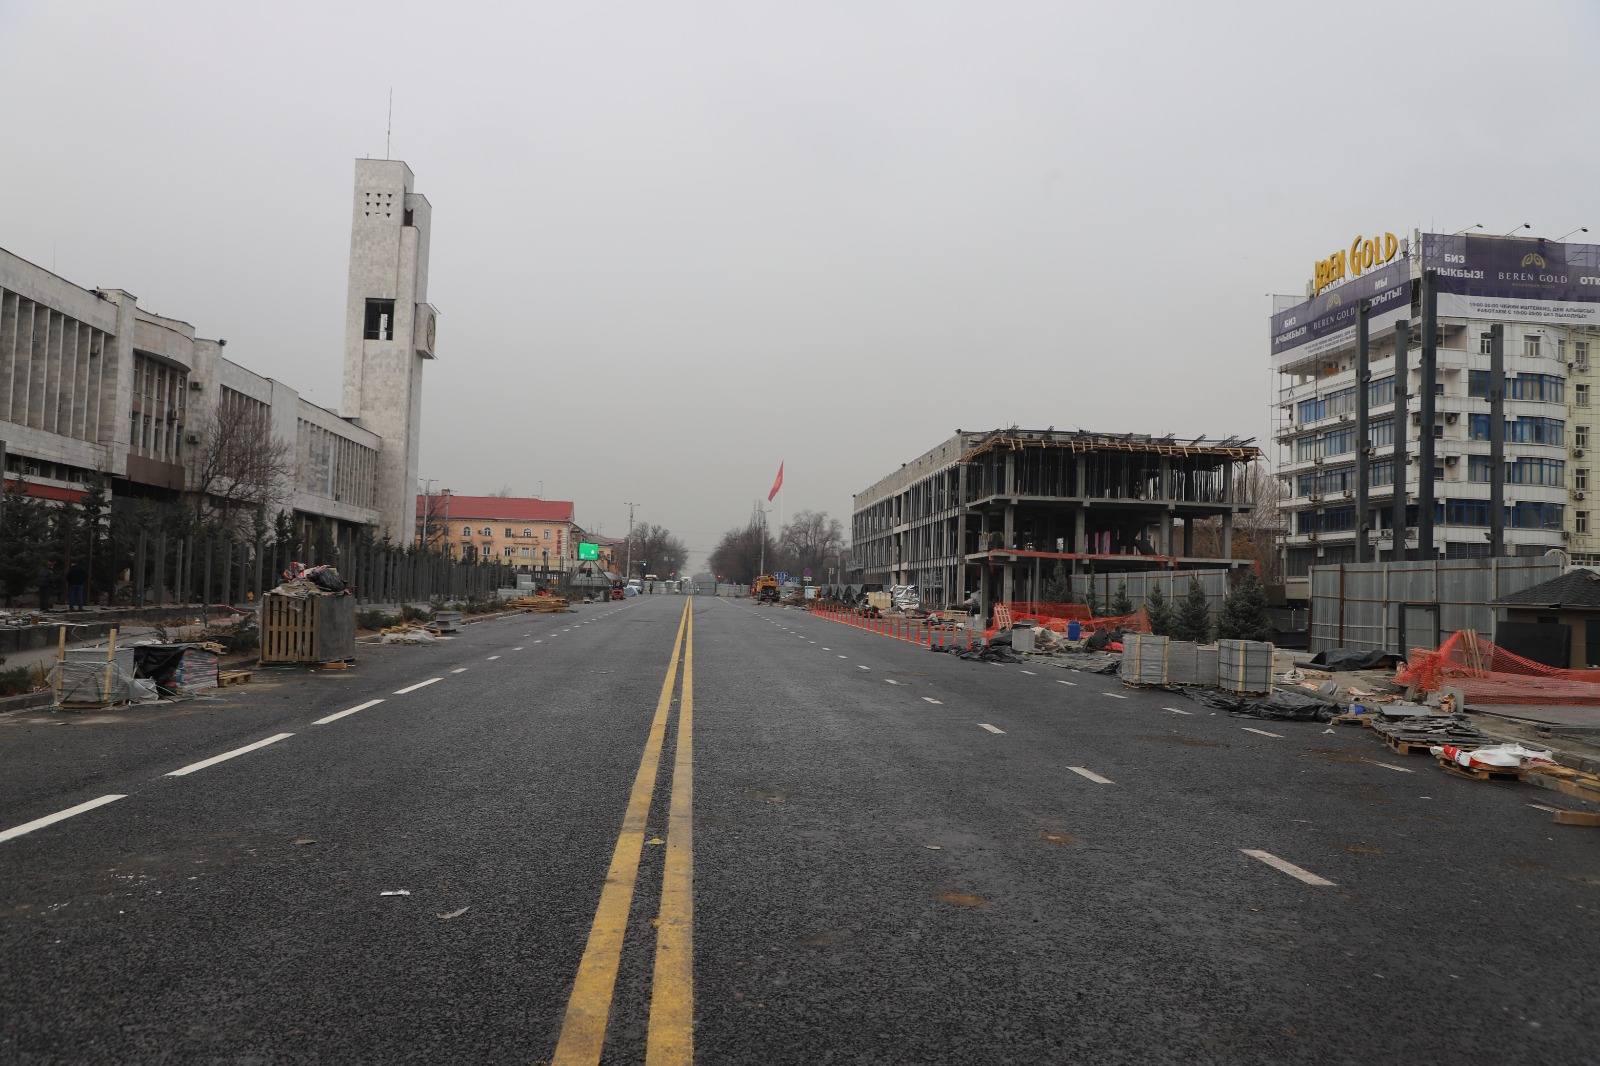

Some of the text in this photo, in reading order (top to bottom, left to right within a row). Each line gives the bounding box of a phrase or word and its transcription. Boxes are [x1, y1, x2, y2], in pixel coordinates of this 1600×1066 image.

[1349, 232, 1398, 276] GOLD
[1444, 253, 1465, 264] БИЗ
[1375, 276, 1388, 291] МЫ
[1498, 271, 1567, 284] BEREN GOLD
[1313, 315, 1335, 330] BEREN
[1336, 306, 1355, 321] GOLD
